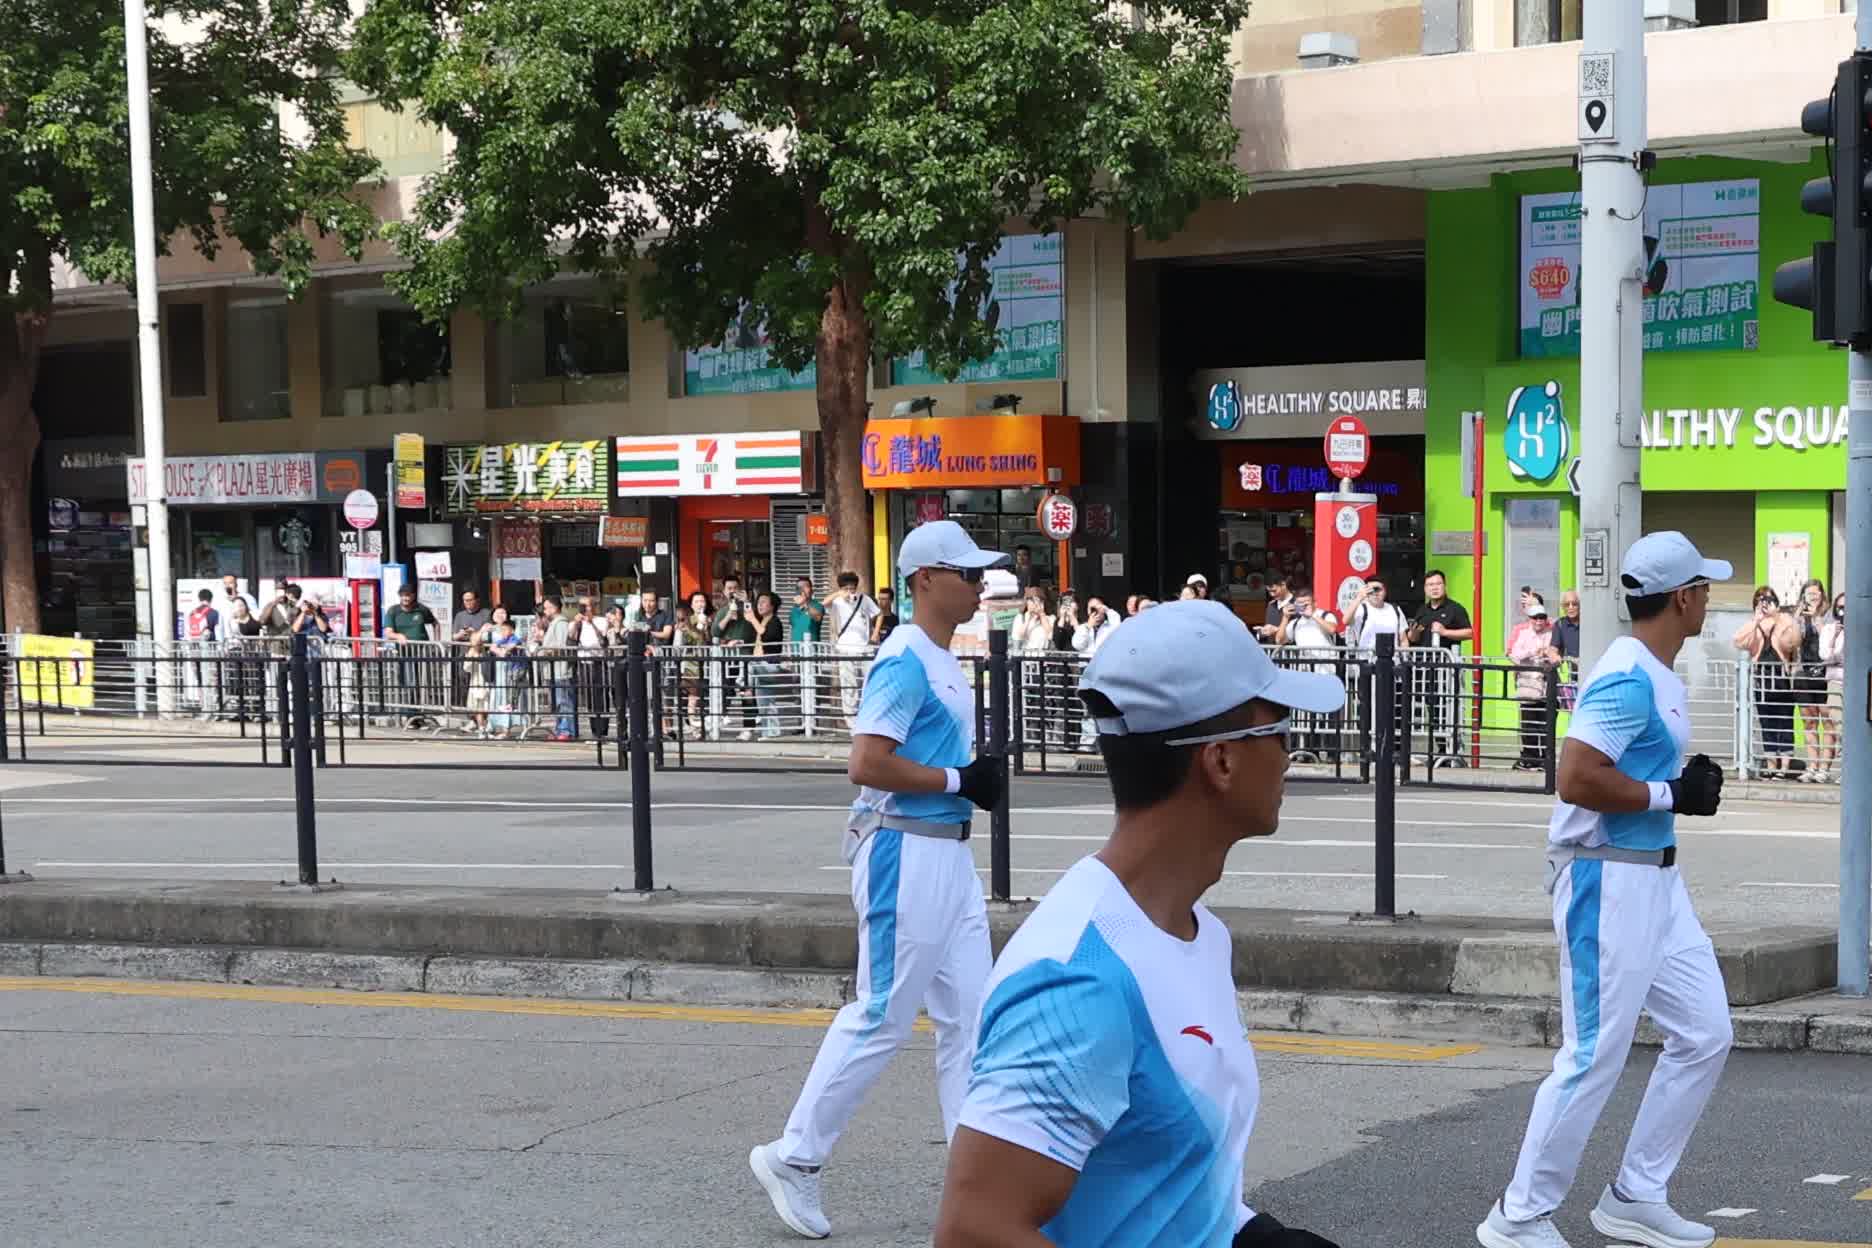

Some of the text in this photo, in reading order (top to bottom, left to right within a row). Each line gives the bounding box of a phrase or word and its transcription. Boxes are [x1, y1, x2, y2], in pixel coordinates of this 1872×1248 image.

[1244, 389, 1402, 415] HEALTHY SQUARE
[1407, 387, 1427, 409] 昇
[1640, 409, 1743, 447] ALTHY
[480, 443, 595, 494] 星光美食
[889, 434, 942, 474] 龍城
[947, 453, 1037, 473] LUNG SHING
[217, 462, 253, 497] PLAZA
[255, 460, 313, 497] 星光廣場
[340, 531, 356, 541] YT
